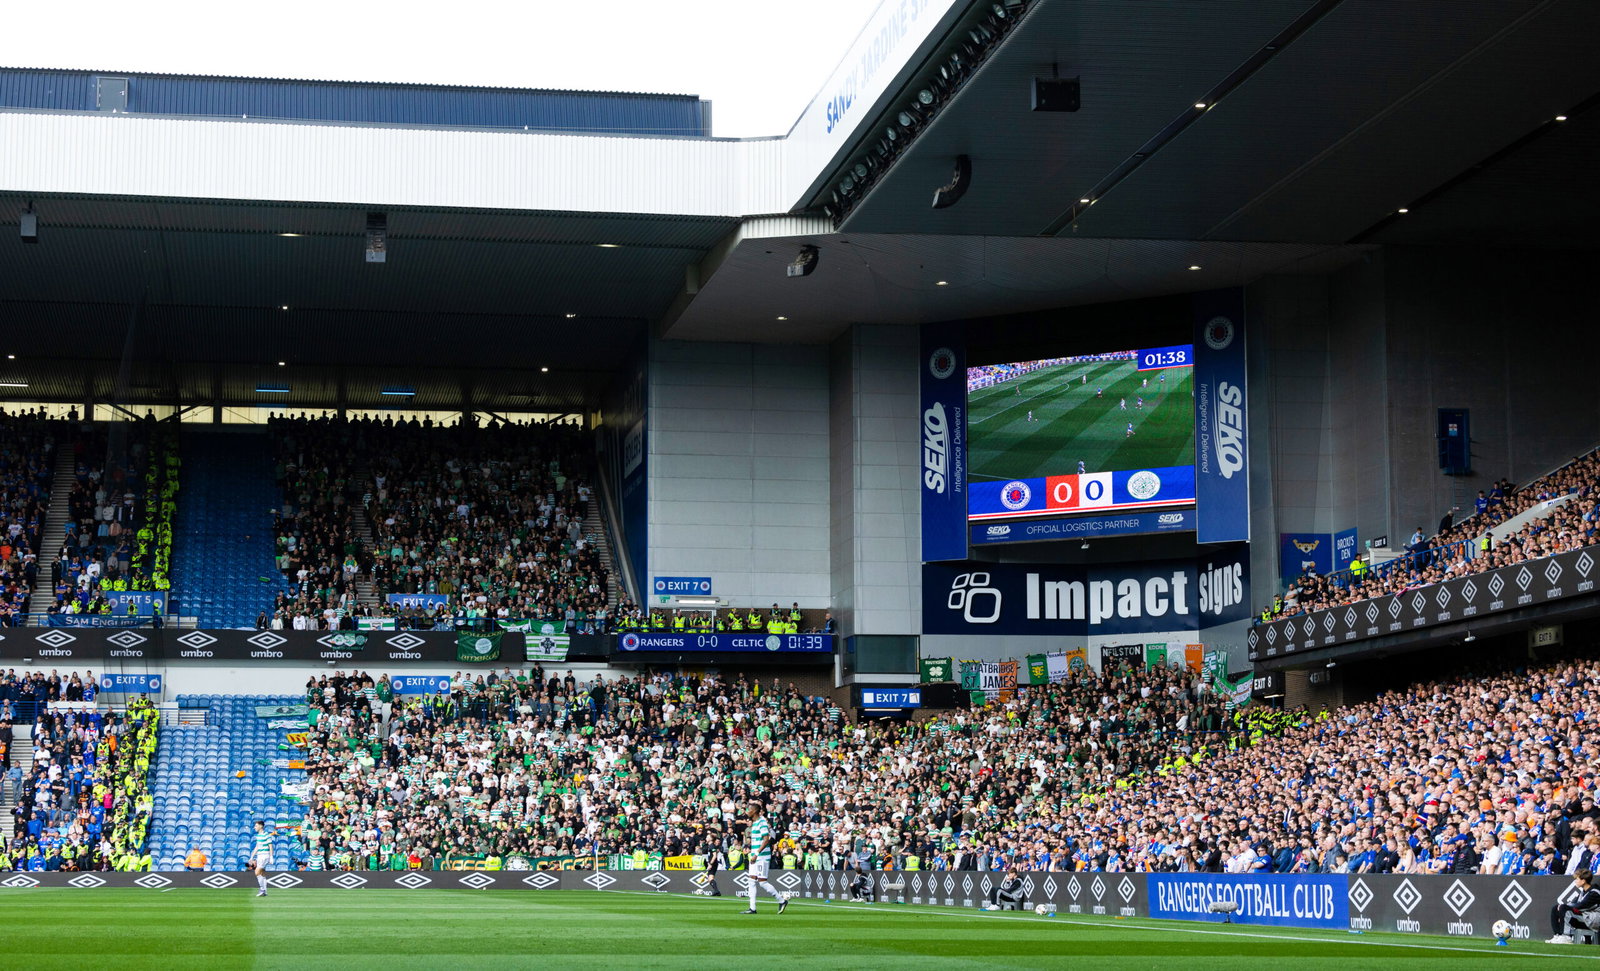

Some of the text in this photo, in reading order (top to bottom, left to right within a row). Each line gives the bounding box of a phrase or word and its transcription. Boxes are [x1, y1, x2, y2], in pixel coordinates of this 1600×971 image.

[827, 0, 908, 134] SANDY JARDINE
[1144, 351, 1186, 367] 01:38
[1199, 384, 1210, 473] Intelligence Delivered
[1219, 382, 1243, 479] SEKO
[924, 402, 945, 494] SEKO
[953, 407, 963, 493] Intelligence Delivered
[1053, 480, 1104, 503] 0 0
[1158, 513, 1184, 524] SEKO
[986, 525, 1011, 536] SEKO
[1026, 519, 1140, 535] OFFICIAL LOGISTICS PARTNER
[1341, 548, 1351, 560] DEN
[667, 581, 699, 591] EXIT 7
[1026, 562, 1243, 624] Impact signs
[120, 595, 151, 604] EXIT 5
[403, 598, 425, 606] EXIT
[65, 616, 89, 626] SAM
[640, 638, 684, 647] RANGERS
[697, 635, 718, 647] 0-0
[731, 638, 764, 647] CELTIC
[39, 648, 72, 657] umbro
[110, 649, 143, 657] umbro
[180, 649, 214, 657] umbro
[250, 650, 283, 658] umbro
[320, 650, 353, 658] umbro
[389, 651, 422, 659] umbro
[116, 676, 146, 684] EXIT 5
[406, 677, 435, 685] EXIT 6
[964, 675, 1016, 689] ST. JAMES
[1254, 677, 1266, 690] EXIT
[1267, 676, 1272, 688] 8
[876, 693, 908, 703] EXIT 7
[1157, 881, 1335, 920] RANGERS FOOTBALL CLUB
[1350, 915, 1373, 930] umbro
[1397, 916, 1420, 933] umbro
[1447, 919, 1473, 936] umbro
